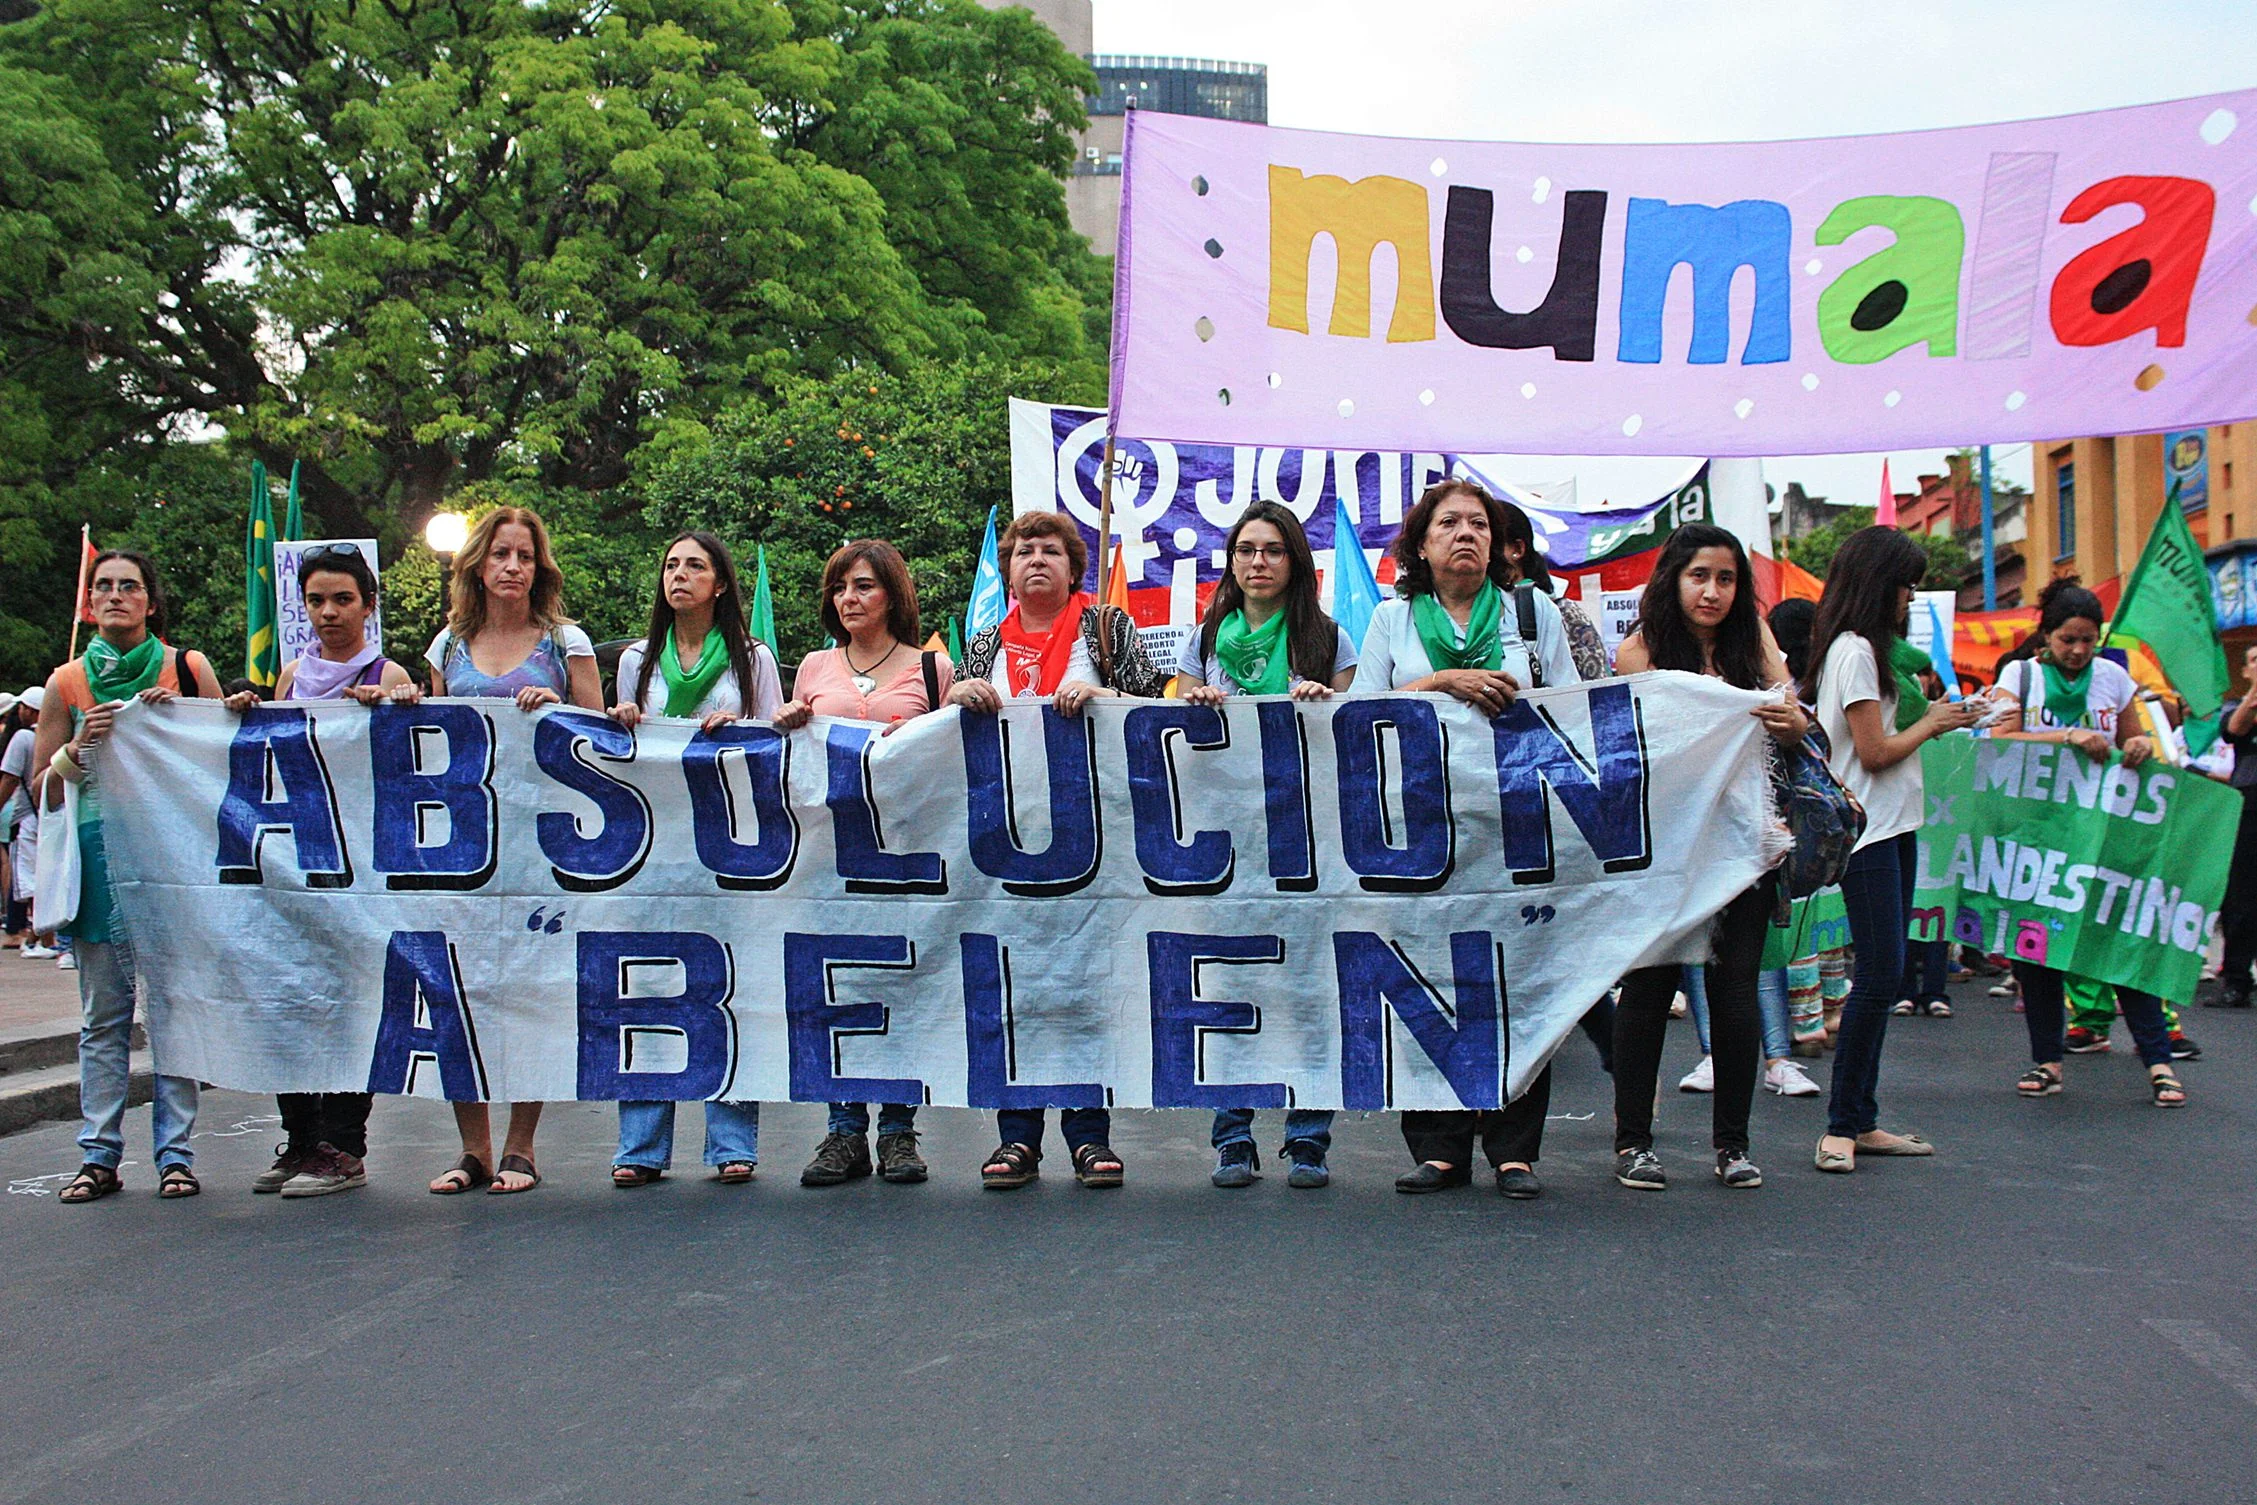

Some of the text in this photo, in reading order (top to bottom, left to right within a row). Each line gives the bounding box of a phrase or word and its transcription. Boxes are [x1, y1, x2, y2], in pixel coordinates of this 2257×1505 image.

[1268, 152, 2217, 364] mumala
[1148, 649, 1172, 659] LEGAL
[1606, 599, 1639, 611] ABSOL
[1149, 657, 1178, 667] EGURO
[215, 683, 1652, 895] ABSOLUCION
[1973, 740, 2176, 825] MENOS
[1915, 833, 2221, 957] LANDESTINO
[366, 930, 491, 1102] A
